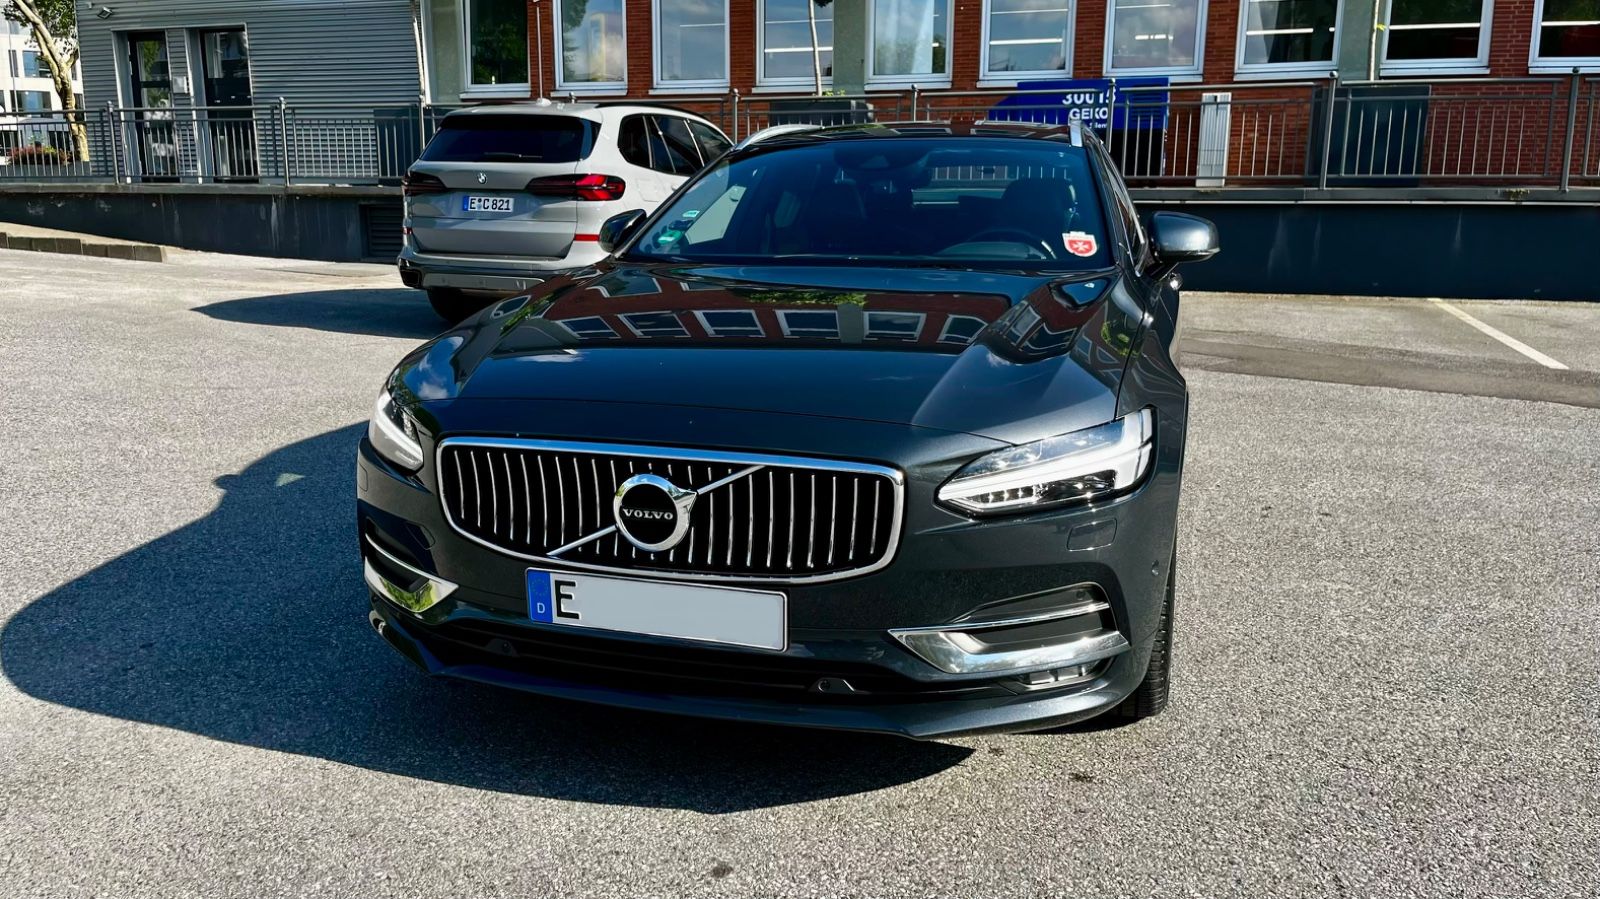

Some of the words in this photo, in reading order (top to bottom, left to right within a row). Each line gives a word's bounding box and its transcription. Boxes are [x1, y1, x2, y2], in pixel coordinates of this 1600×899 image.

[1070, 107, 1108, 119] GEKO
[491, 198, 511, 211] 821
[622, 508, 674, 520] VOLVO
[536, 602, 546, 614] D
[554, 579, 581, 620] E
